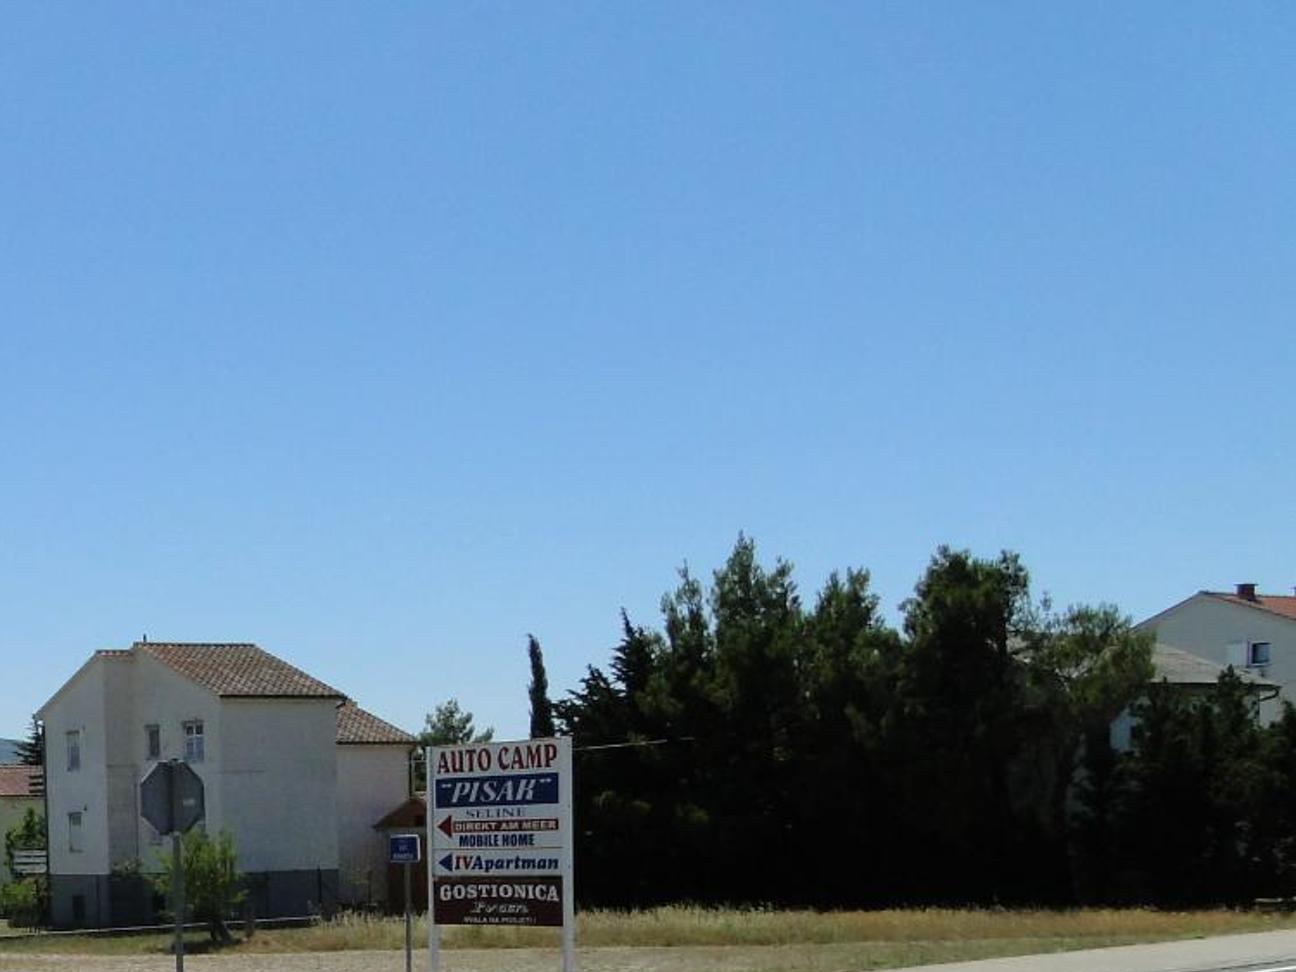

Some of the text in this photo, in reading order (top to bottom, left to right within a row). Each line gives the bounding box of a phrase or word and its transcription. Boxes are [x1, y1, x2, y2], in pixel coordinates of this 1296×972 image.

[437, 744, 558, 774] AUTO CAMP
[465, 808, 527, 818] SELINE
[455, 819, 557, 832] DIREKT AM MEER
[459, 834, 535, 847] MOBILE HOME
[439, 884, 560, 901] GOSTIONICA
